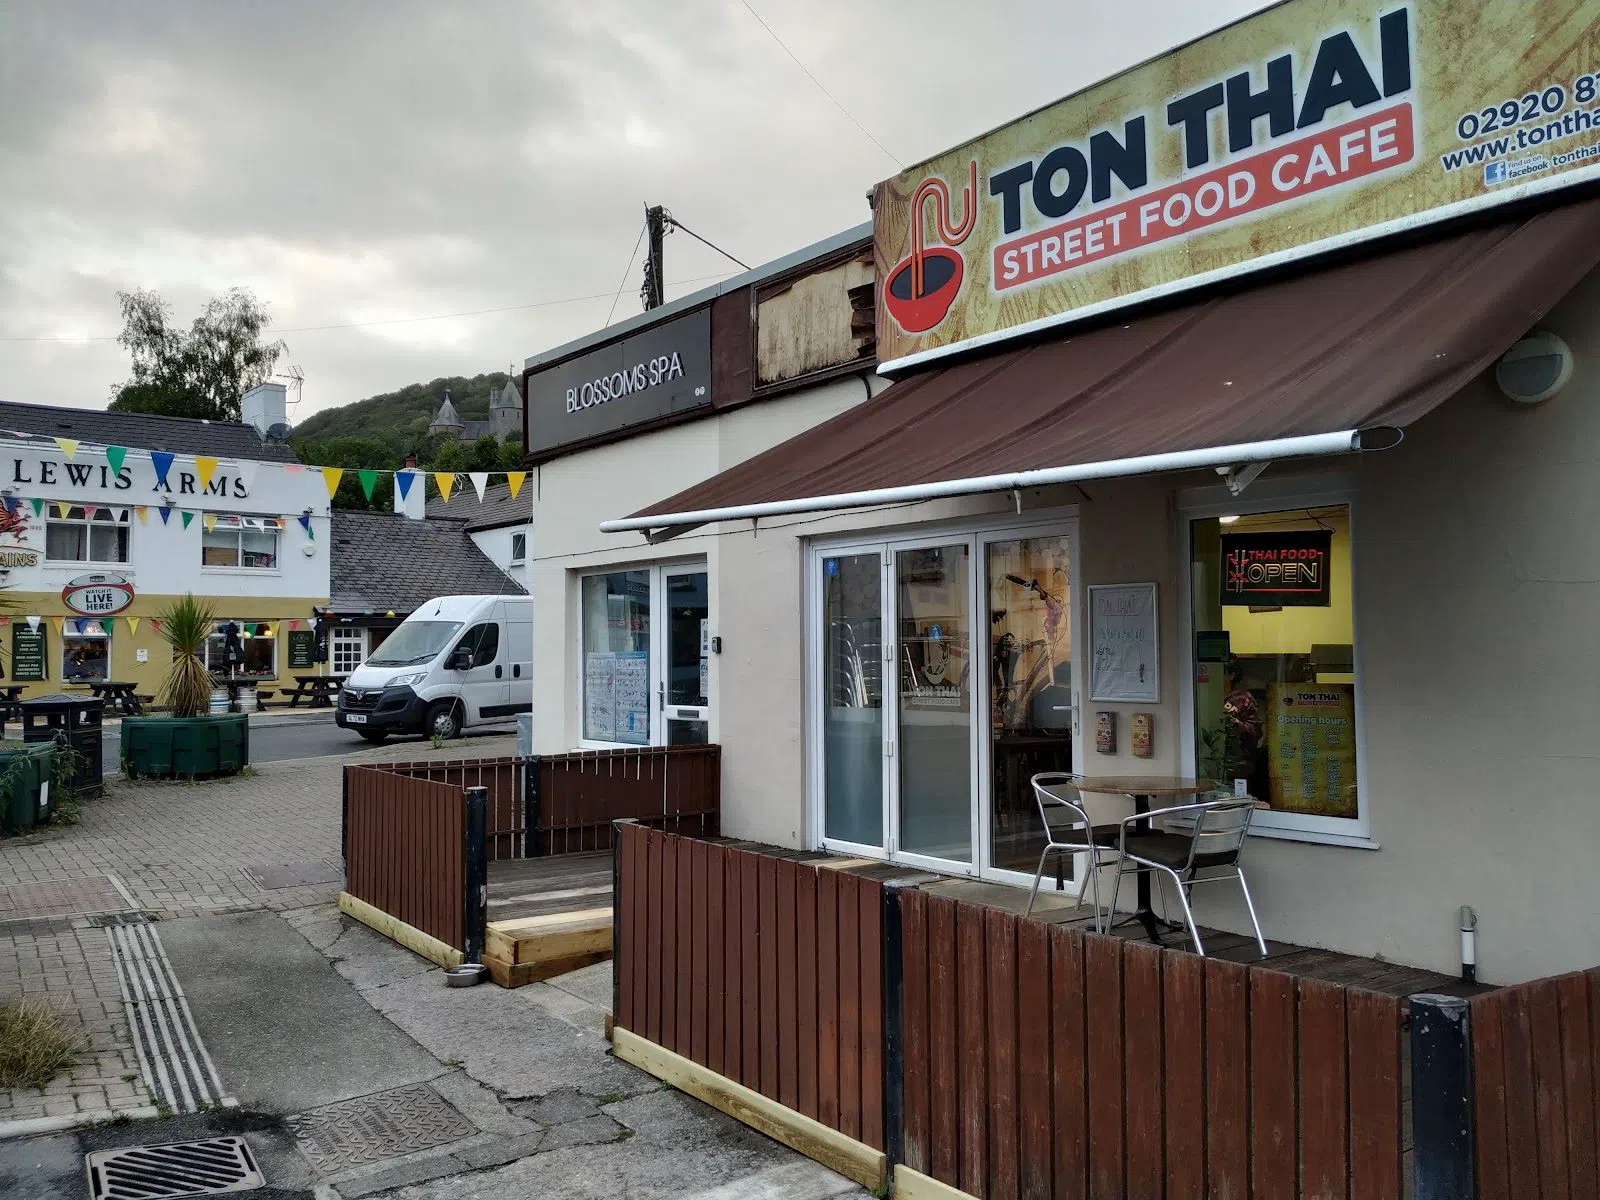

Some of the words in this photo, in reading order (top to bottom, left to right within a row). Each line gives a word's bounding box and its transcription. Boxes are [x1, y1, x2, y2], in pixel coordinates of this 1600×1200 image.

[1458, 86, 1564, 139] 02920
[1575, 73, 1600, 102] 8
[990, 114, 1148, 234] TON
[1167, 8, 1411, 169] THAI
[1508, 159, 1522, 168] Find
[1508, 161, 1549, 179] facebook
[1001, 212, 1127, 280] STREET
[1139, 170, 1257, 239] FOOD
[1271, 117, 1400, 193] CAFE
[566, 363, 646, 413] BLOSSOMS
[649, 352, 683, 386] SPA
[13, 459, 132, 489] LEWIS
[152, 472, 250, 498] ARMS
[1248, 550, 1277, 560] THAI
[1280, 549, 1317, 560] FOOD
[1247, 562, 1318, 583] OPEN
[85, 593, 113, 603] LIVE
[935, 685, 960, 698] THAI
[1277, 714, 1318, 724] Opening
[1318, 715, 1347, 725] hours
